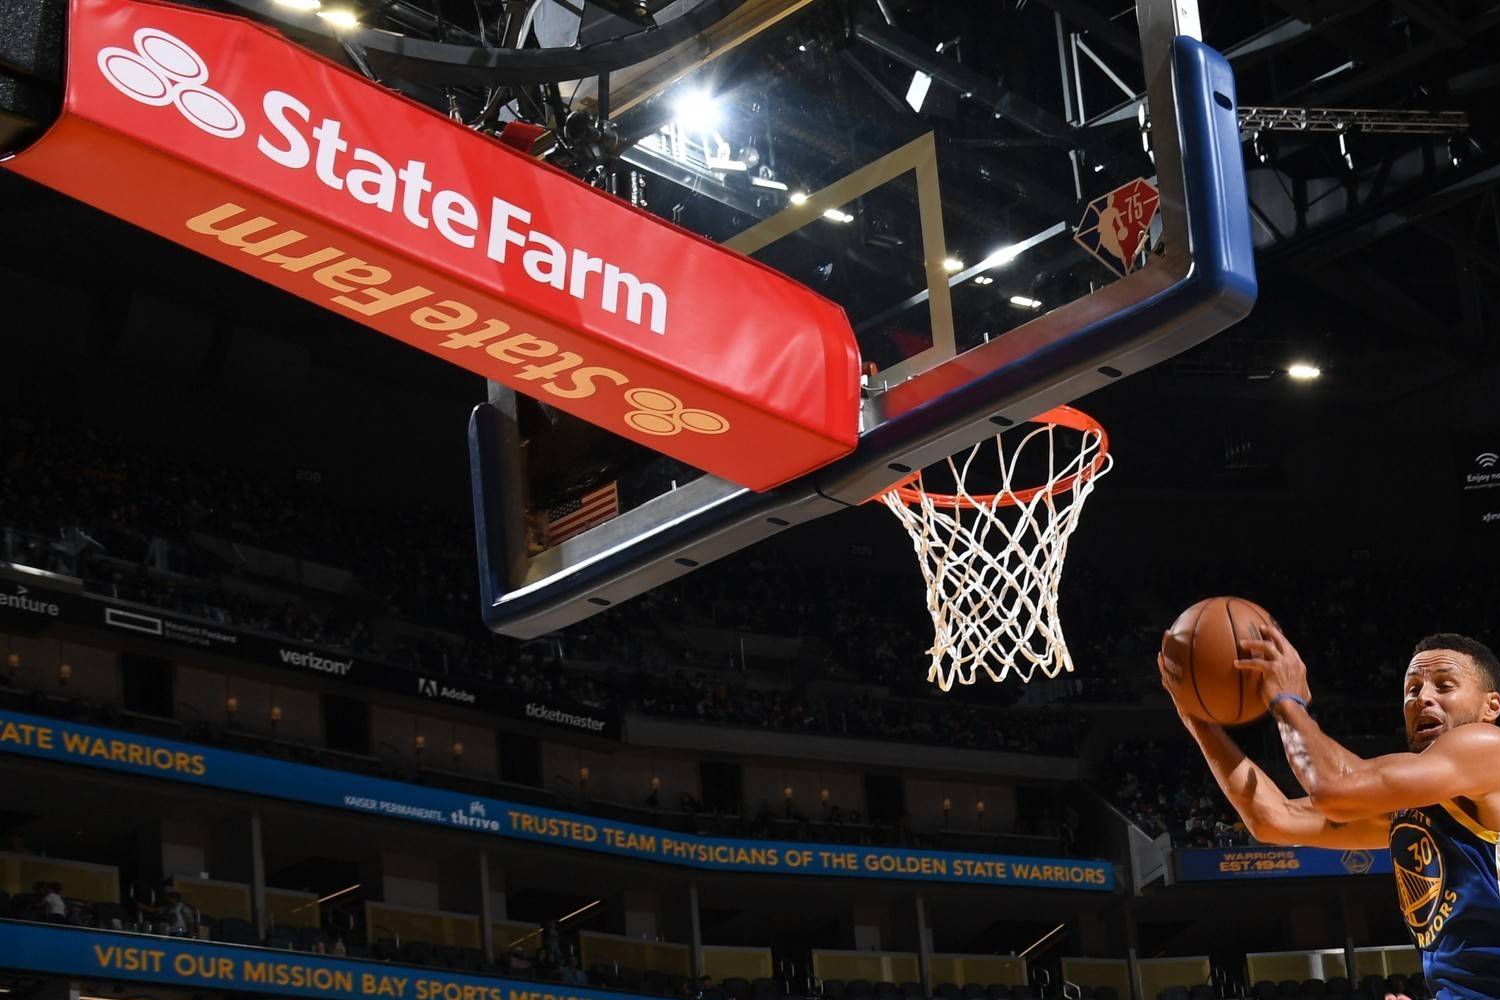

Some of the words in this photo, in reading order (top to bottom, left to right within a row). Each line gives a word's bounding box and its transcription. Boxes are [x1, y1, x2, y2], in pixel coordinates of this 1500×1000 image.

[1124, 191, 1144, 224] 75
[279, 649, 348, 676] verizon
[441, 686, 476, 703] Adobe
[526, 703, 606, 731] ticketmaster
[61, 731, 207, 776] WARRIORS
[344, 795, 377, 811] KAISER
[451, 808, 500, 831] thrive
[508, 811, 598, 843] TRUSTED
[602, 827, 656, 852] TEAM
[662, 838, 779, 867] PHYSICIANS
[784, 849, 813, 868] OF
[819, 851, 858, 871] THE
[864, 854, 948, 875] GOLDEN
[952, 859, 1007, 879] STATE
[1012, 863, 1106, 885] WARRIORS
[1223, 851, 1295, 861] WARRIORS
[1406, 837, 1433, 873] 30
[1416, 890, 1457, 950] RRIORS
[94, 945, 166, 973] VISIT
[174, 953, 235, 980] OUR
[242, 959, 353, 992] MISSION
[361, 973, 408, 998] BAY
